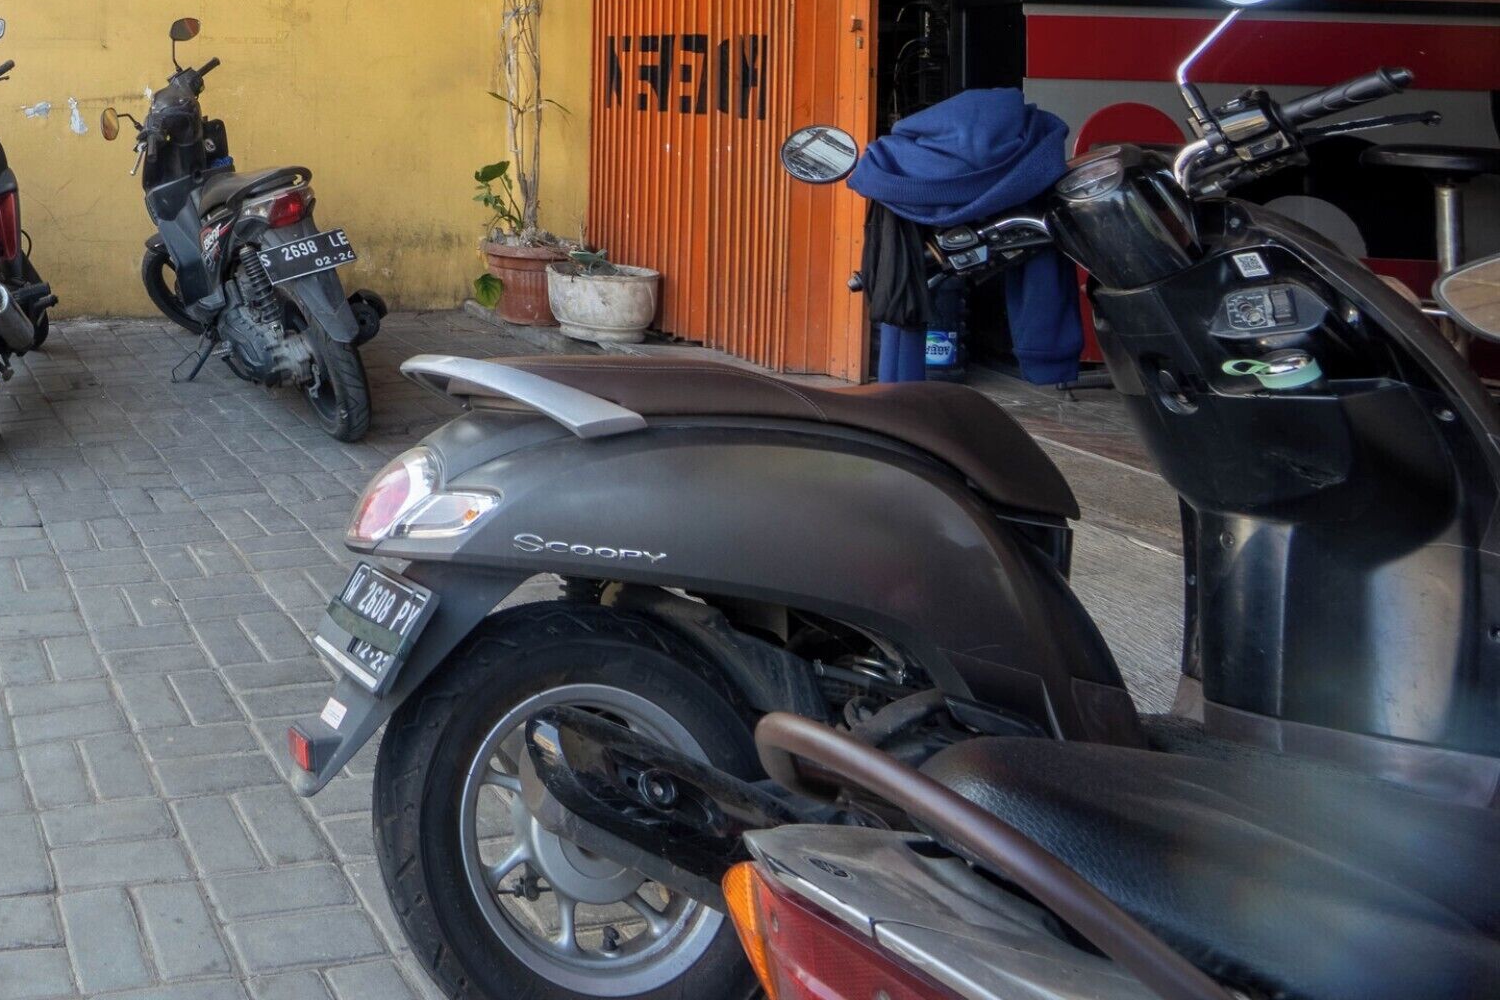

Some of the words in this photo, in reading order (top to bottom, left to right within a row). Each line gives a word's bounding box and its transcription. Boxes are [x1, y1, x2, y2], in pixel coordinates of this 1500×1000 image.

[260, 254, 272, 267] S
[281, 240, 318, 262] 2698
[328, 231, 350, 247] LE
[357, 580, 397, 624] 2608
[388, 601, 422, 636] PY
